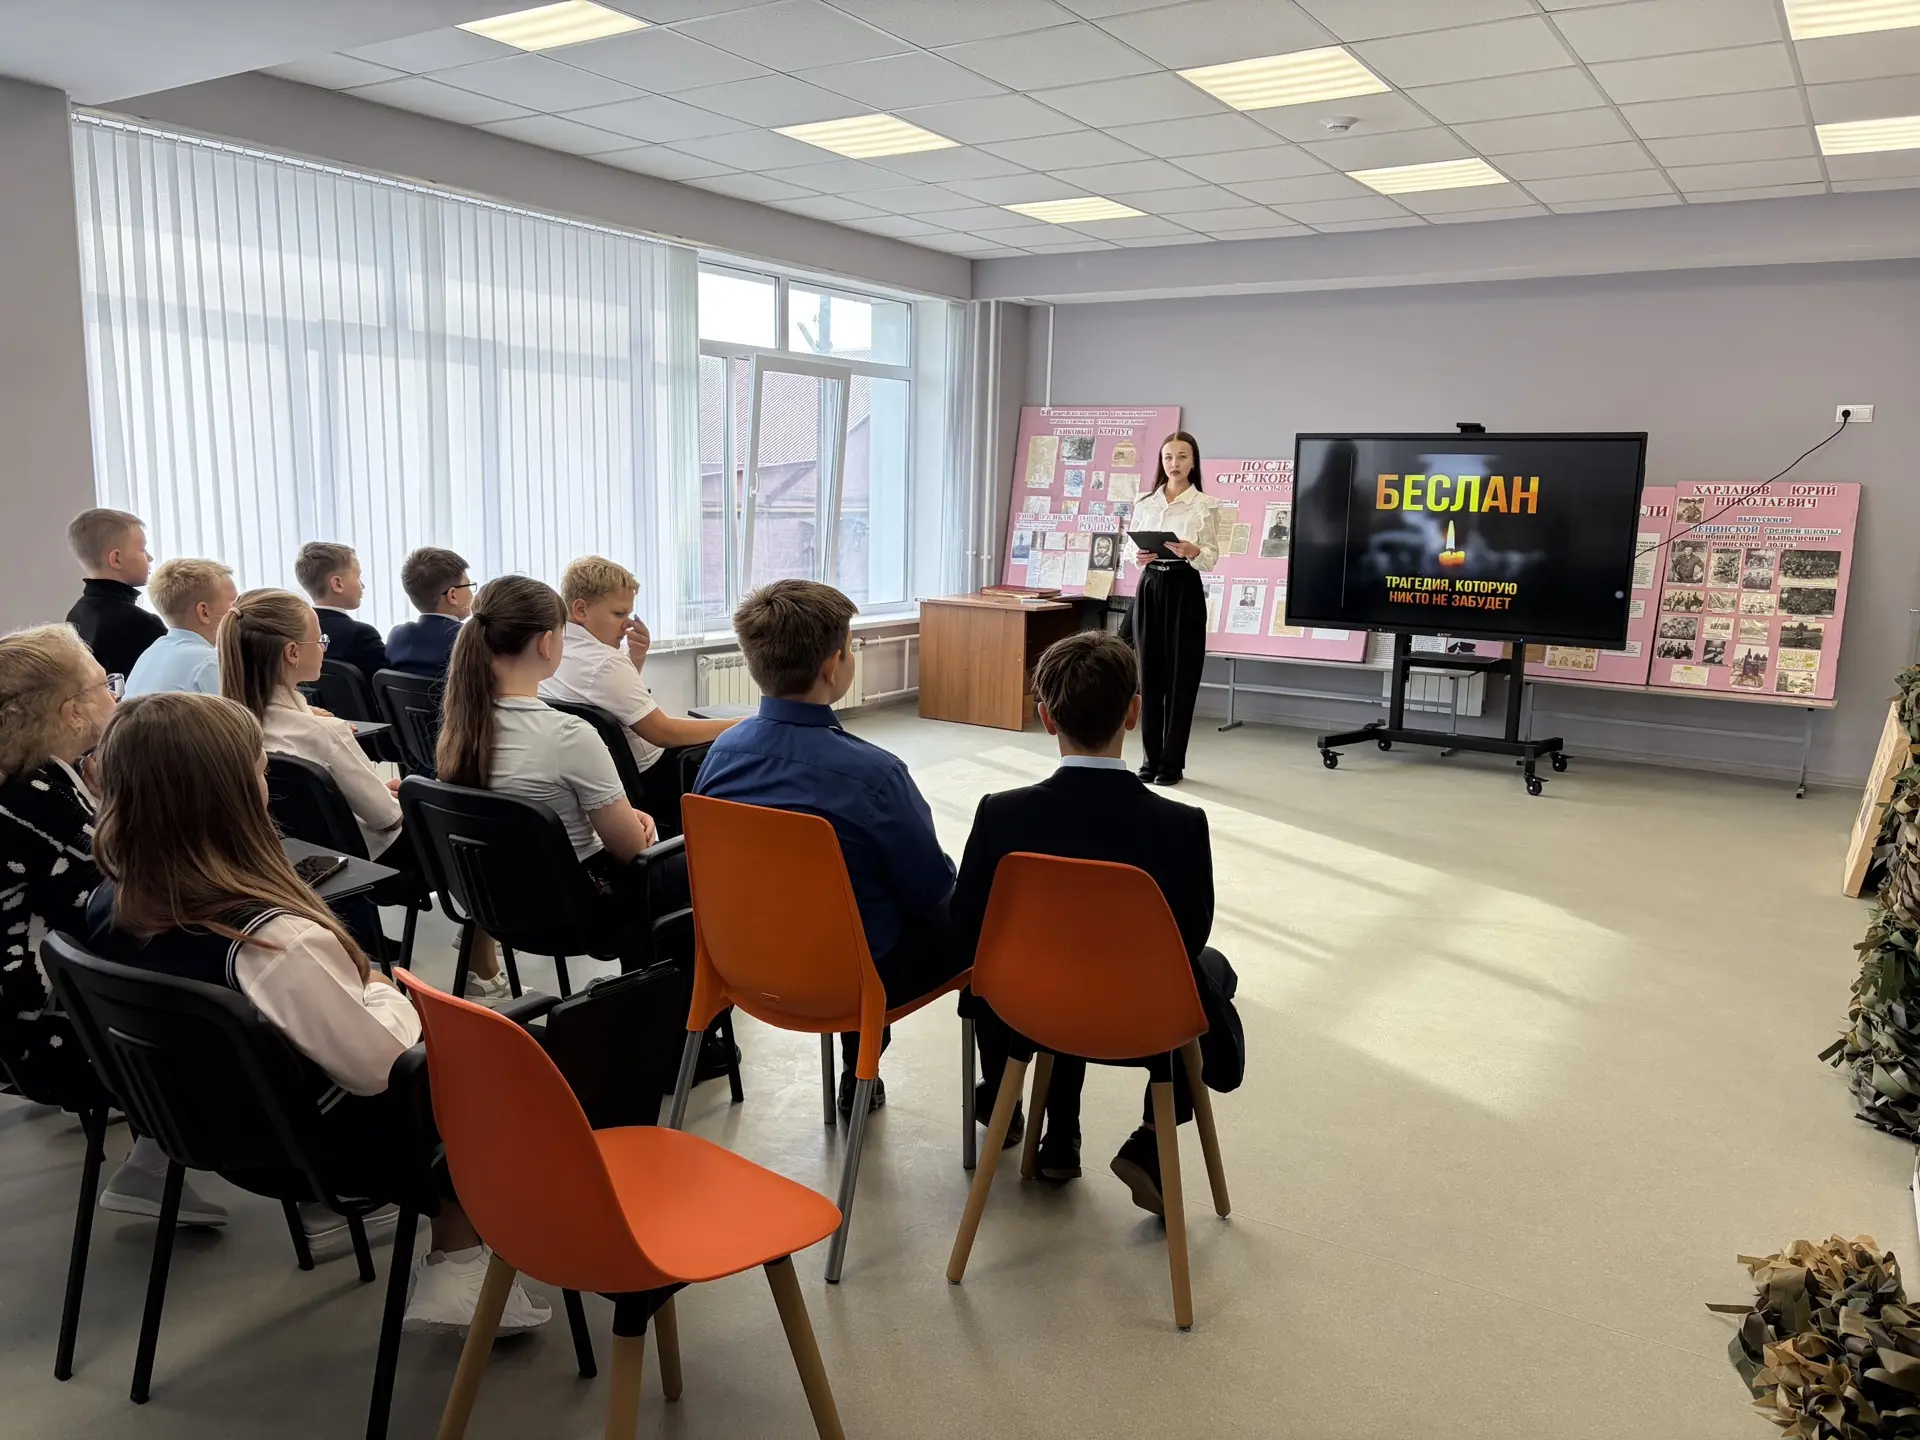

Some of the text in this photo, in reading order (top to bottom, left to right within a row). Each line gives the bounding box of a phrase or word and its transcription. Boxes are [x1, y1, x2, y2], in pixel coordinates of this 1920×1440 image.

[1099, 428, 1132, 436] КОРПУС
[1241, 461, 1293, 472] ПОСЛЕ
[1376, 474, 1540, 514] БЕСЛАН
[1693, 484, 1837, 496] ХАРЛАНОВ ЮРИЙ
[1715, 497, 1818, 508] НИКОЛАЕВИЧ
[1639, 506, 1668, 517] ЛИ
[1737, 515, 1791, 524] выпускник
[1385, 575, 1518, 595] ТРАГЕДИЯ, КОТОРУЮ
[1389, 591, 1512, 610] НИКТО НЕ ЗАБУДЕТ
